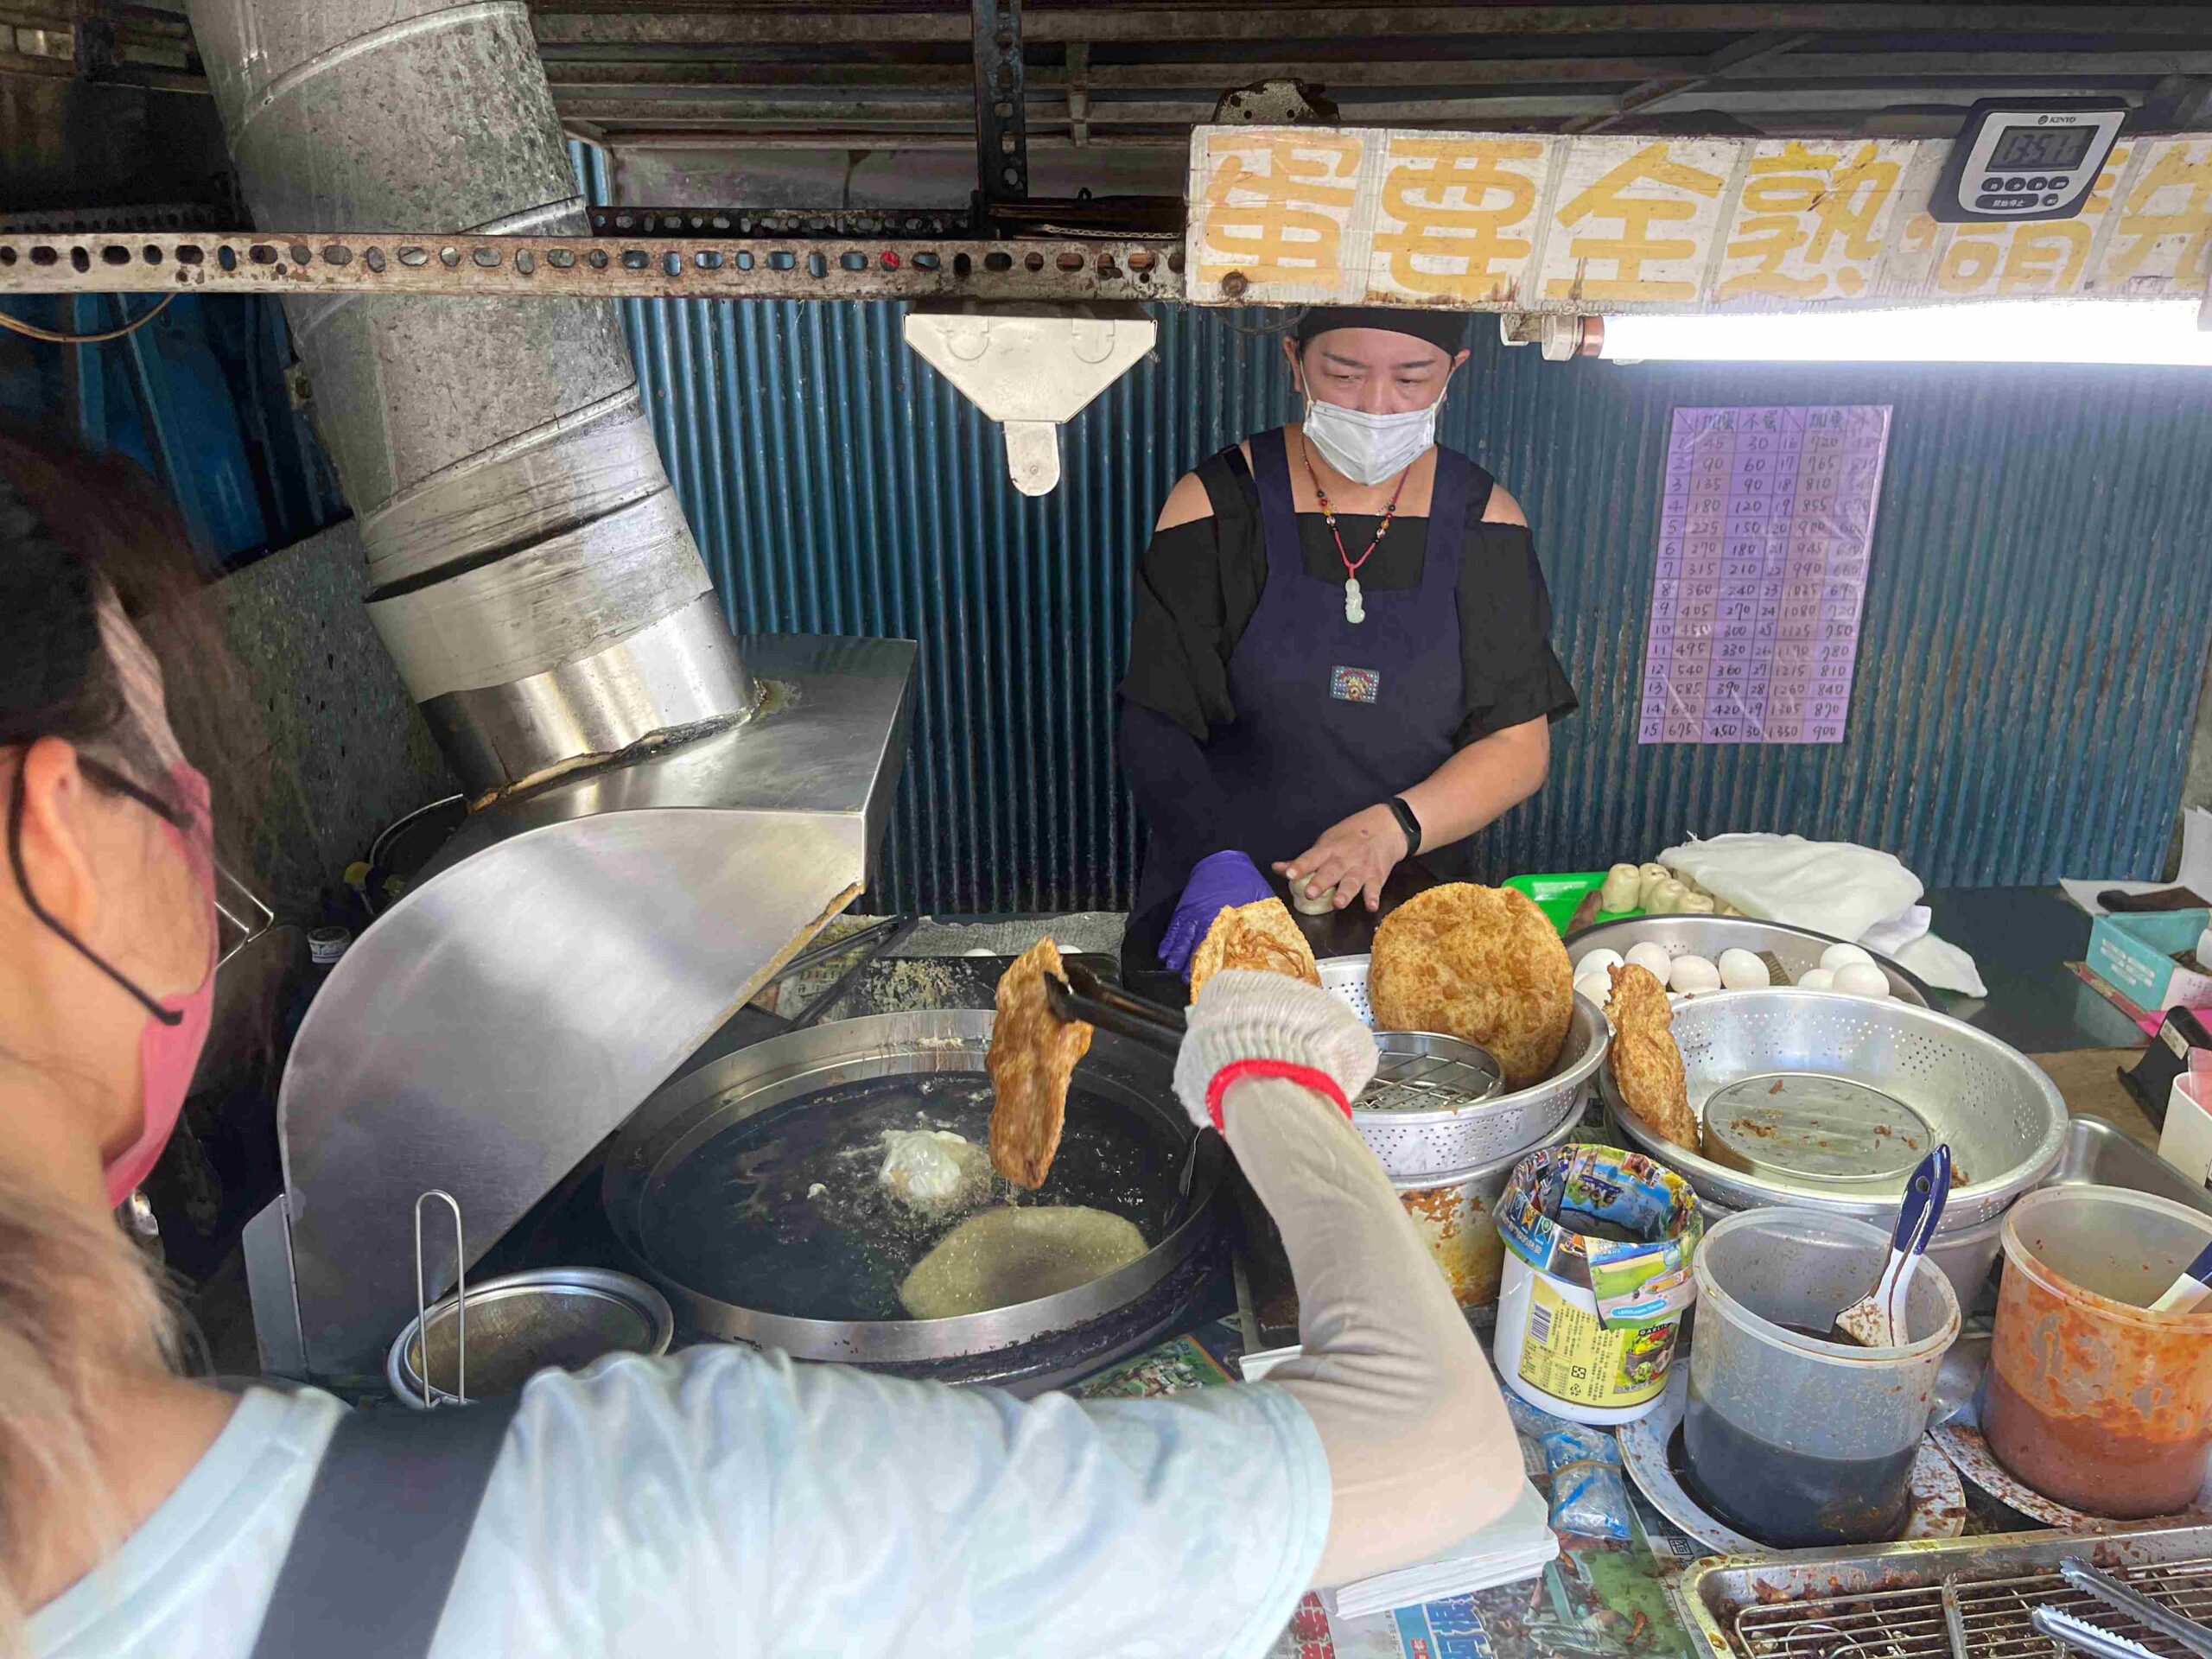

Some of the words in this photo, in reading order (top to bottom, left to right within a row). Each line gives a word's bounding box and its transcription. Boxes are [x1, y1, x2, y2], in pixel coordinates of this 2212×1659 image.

[1678, 437, 1685, 449] 1
[1747, 435, 1769, 450] 30
[1810, 435, 1839, 454] 720
[1673, 457, 1686, 470] 2
[1703, 456, 1724, 473] 90
[1744, 457, 1765, 472] 60
[1781, 456, 1795, 471] 17
[1808, 454, 1839, 473] 765
[1672, 478, 1681, 492] 3
[1695, 478, 1722, 492] 135
[1744, 478, 1763, 494] 90
[1777, 479, 1791, 492] 18
[1806, 478, 1831, 492] 810
[1668, 499, 1683, 512] 4
[1694, 499, 1721, 513] 180
[1735, 499, 1762, 513] 120
[1776, 499, 1790, 516] 19
[1802, 496, 1833, 512] 855
[1666, 519, 1679, 535] 5
[1691, 520, 1719, 536] 225
[1734, 521, 1761, 535] 150
[1771, 523, 1788, 535] 20
[1798, 520, 1826, 537] 900
[1664, 542, 1675, 556] 6
[1691, 542, 1716, 558] 270
[1732, 543, 1756, 556] 180
[1797, 542, 1822, 556] 945
[1663, 561, 1674, 577] 7
[1688, 563, 1717, 575] 315
[1729, 563, 1756, 575] 210
[1793, 562, 1822, 578] 990
[1833, 563, 1859, 577] 660
[1662, 583, 1671, 597] 8
[1686, 583, 1712, 596] 360
[1727, 584, 1755, 596] 240
[1764, 583, 1778, 597] 23
[1830, 582, 1856, 601] 690
[1660, 601, 1669, 616] 9
[1680, 603, 1713, 617] 405
[1726, 602, 1751, 621] 270
[1761, 606, 1776, 616] 24
[1784, 604, 1816, 618] 1080
[1656, 625, 1670, 634] 10
[1681, 623, 1708, 636] 450
[1724, 624, 1746, 637] 300
[1825, 624, 1853, 639] 750
[1654, 644, 1666, 656] 11
[1675, 642, 1706, 656] 495
[1722, 643, 1745, 657] 330
[1777, 645, 1809, 658] 1170
[1821, 645, 1849, 662] 780
[1651, 664, 1664, 675] 12
[1678, 664, 1703, 676] 540
[1717, 664, 1742, 677] 360
[1753, 663, 1767, 677] 27
[1776, 664, 1807, 677] 1215
[1821, 664, 1847, 677] 810
[1649, 682, 1662, 695] 13
[1675, 682, 1702, 696] 585
[1717, 681, 1740, 698] 390
[1751, 683, 1765, 696] 28
[1773, 683, 1805, 696] 1260
[1817, 683, 1844, 696] 840
[1646, 702, 1660, 715] 14
[1671, 702, 1696, 715] 630
[1712, 704, 1740, 716] 420
[1748, 702, 1763, 717] 29
[1815, 702, 1840, 718] 870
[1644, 722, 1659, 737] 15
[1669, 721, 1694, 738] 675
[1712, 724, 1737, 737] 450
[1746, 725, 1760, 737] 30
[1769, 726, 1798, 739] 1350
[1813, 725, 1836, 741] 900
